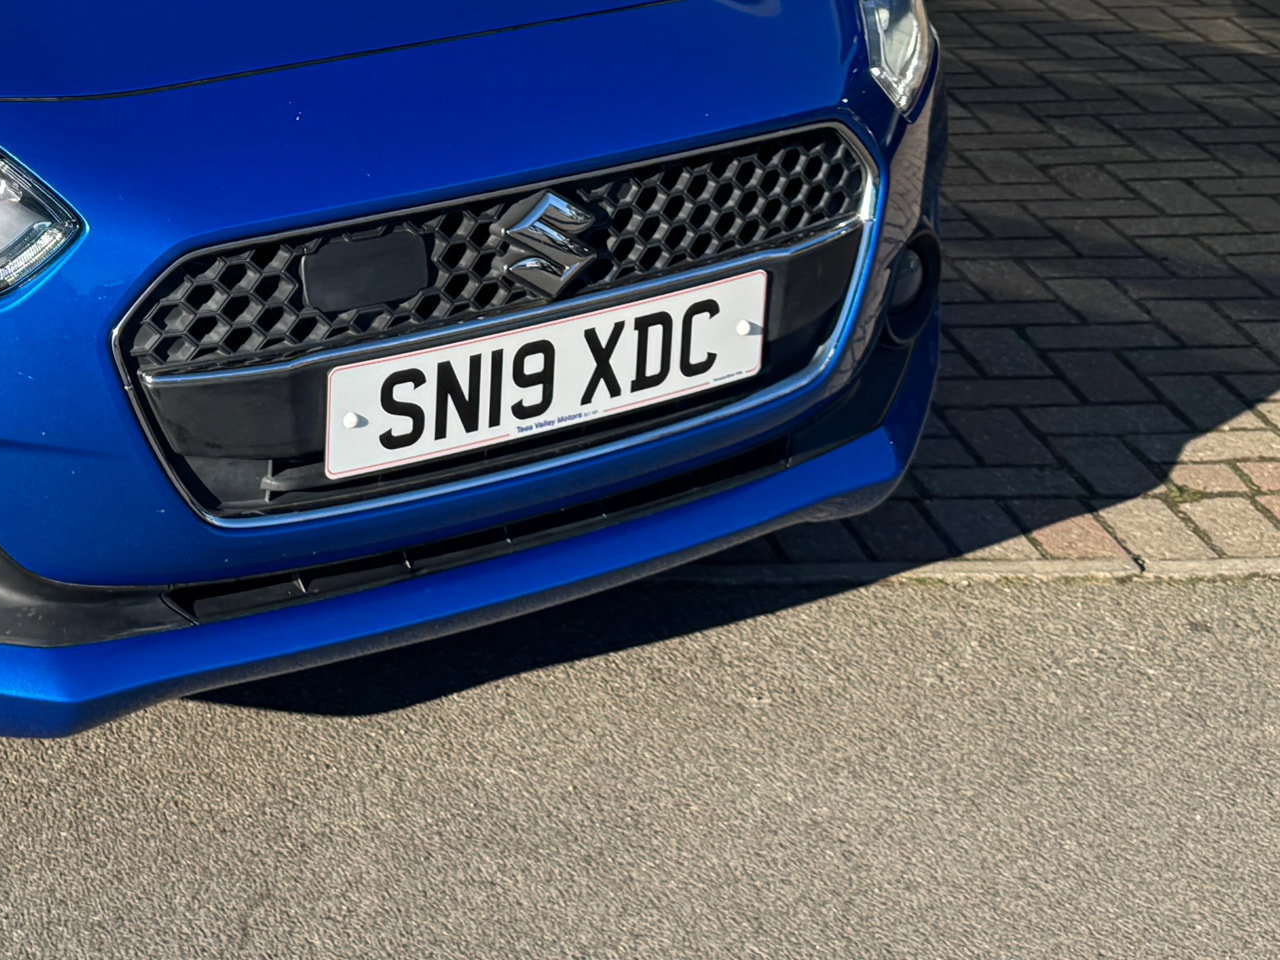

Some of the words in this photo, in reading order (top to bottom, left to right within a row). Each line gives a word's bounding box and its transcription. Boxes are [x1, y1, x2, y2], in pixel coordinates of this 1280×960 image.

[378, 339, 556, 451] SN19
[580, 298, 721, 406] XDC
[534, 418, 556, 429] Valley
[557, 412, 583, 423] Motors
